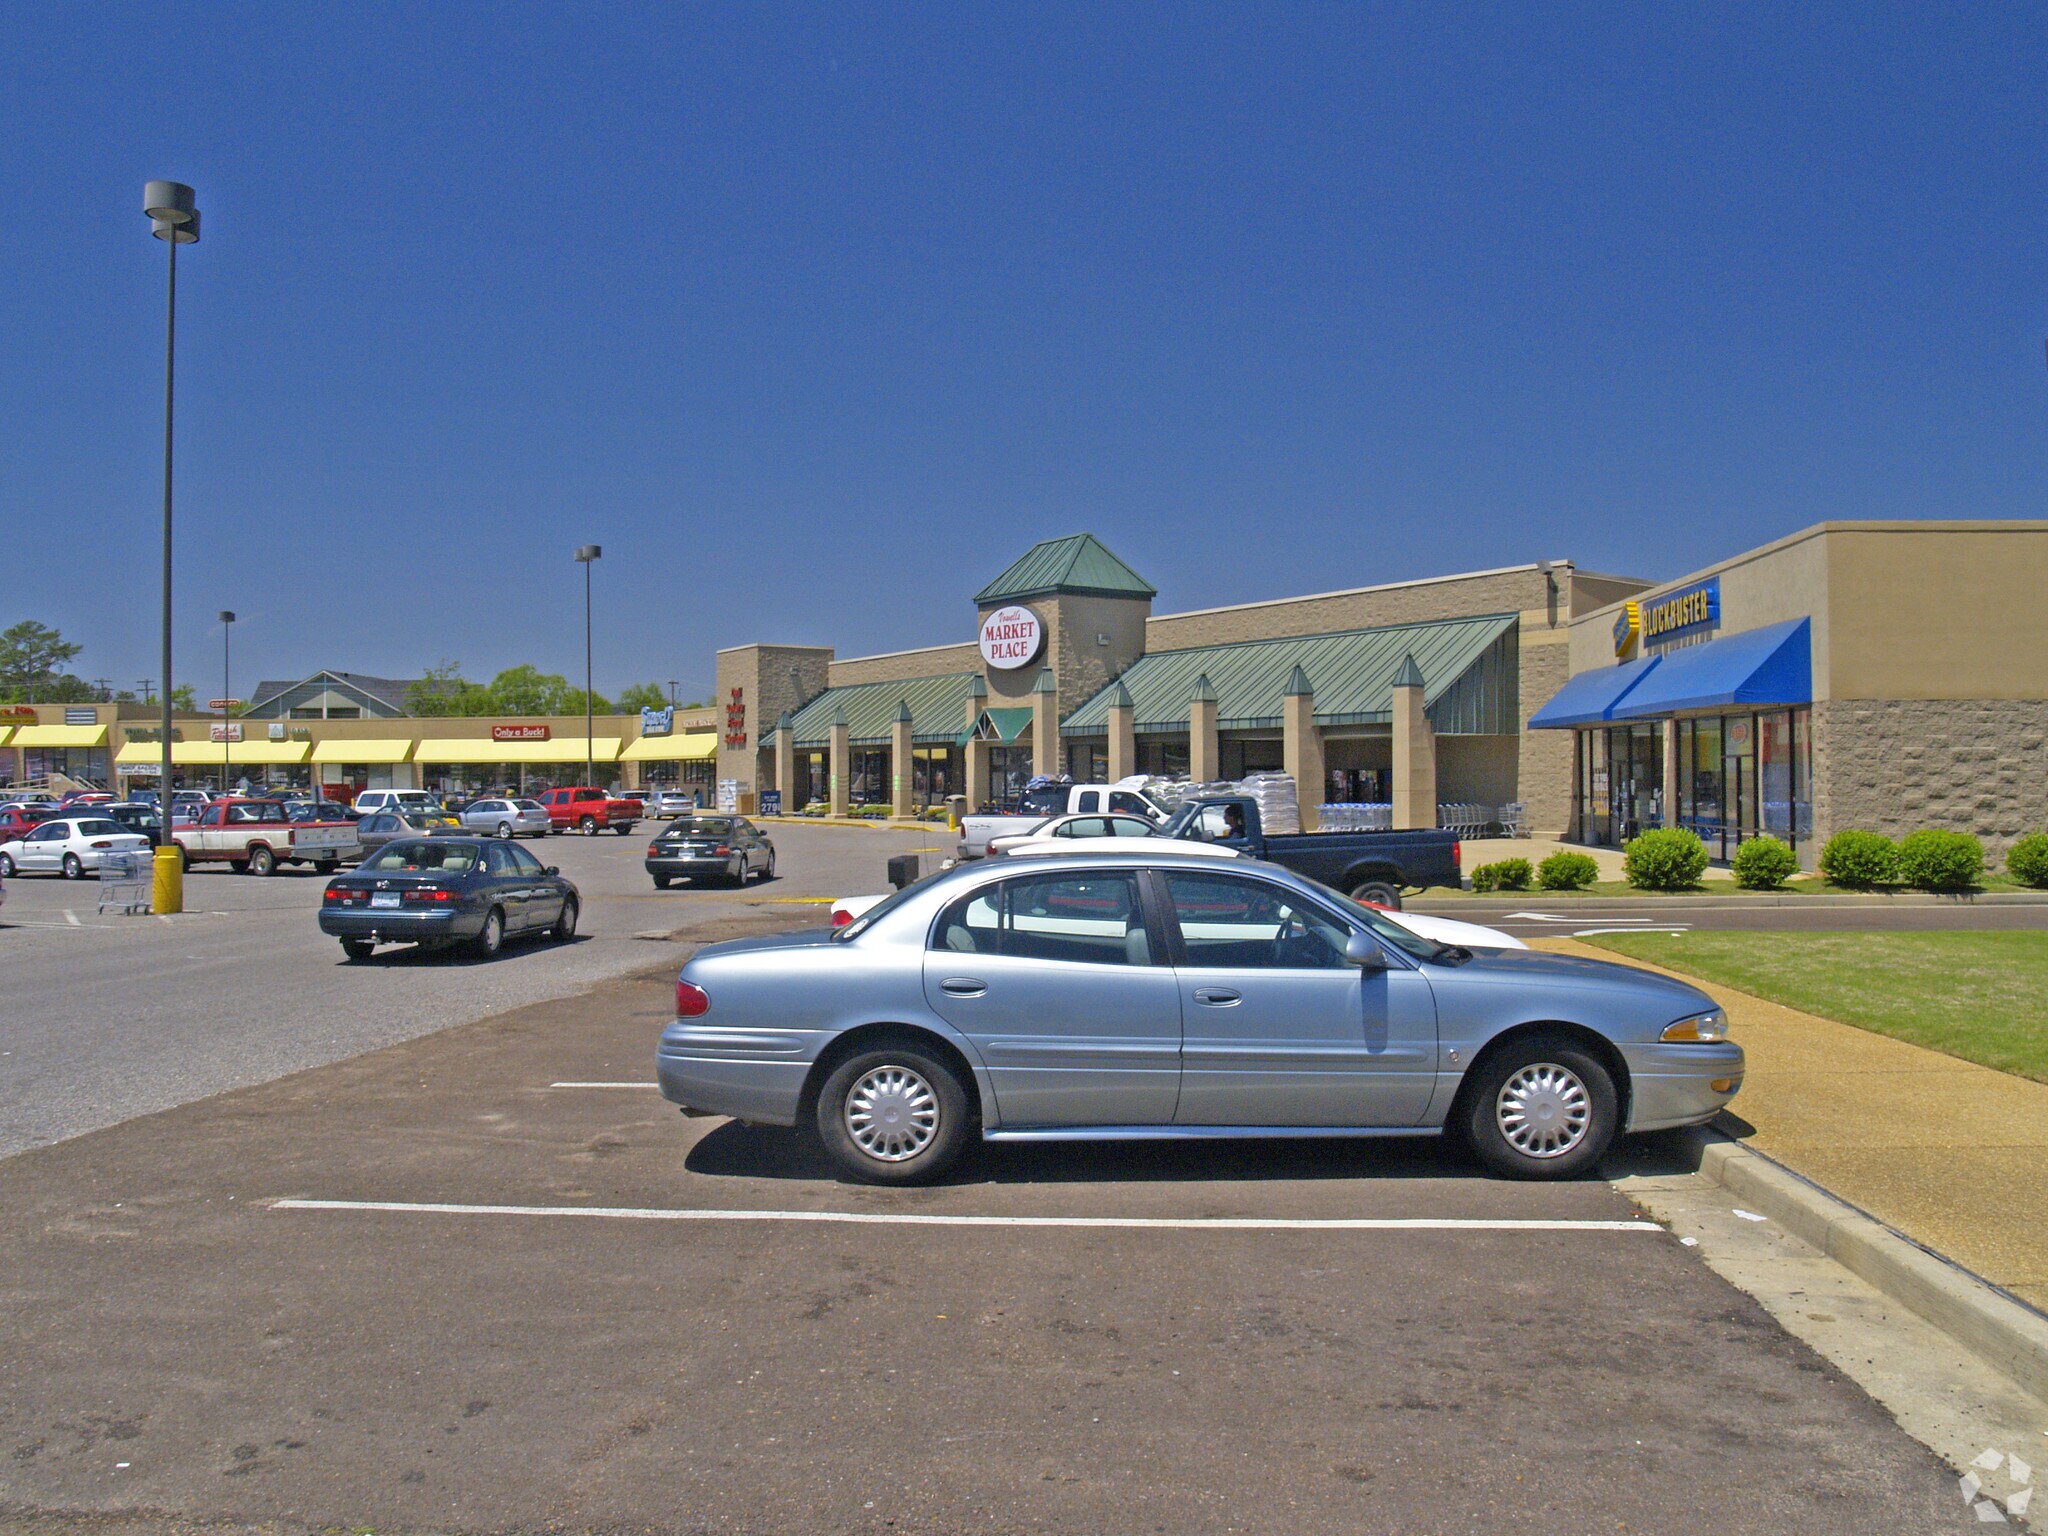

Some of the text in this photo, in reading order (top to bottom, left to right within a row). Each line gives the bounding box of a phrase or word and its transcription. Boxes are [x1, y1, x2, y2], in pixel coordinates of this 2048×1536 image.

[1642, 588, 1708, 637] BLOCKBUSTER
[985, 621, 1034, 641] MARKET
[991, 641, 1027, 659] PLACE
[494, 727, 513, 737] Only
[523, 727, 545, 736] Buck!
